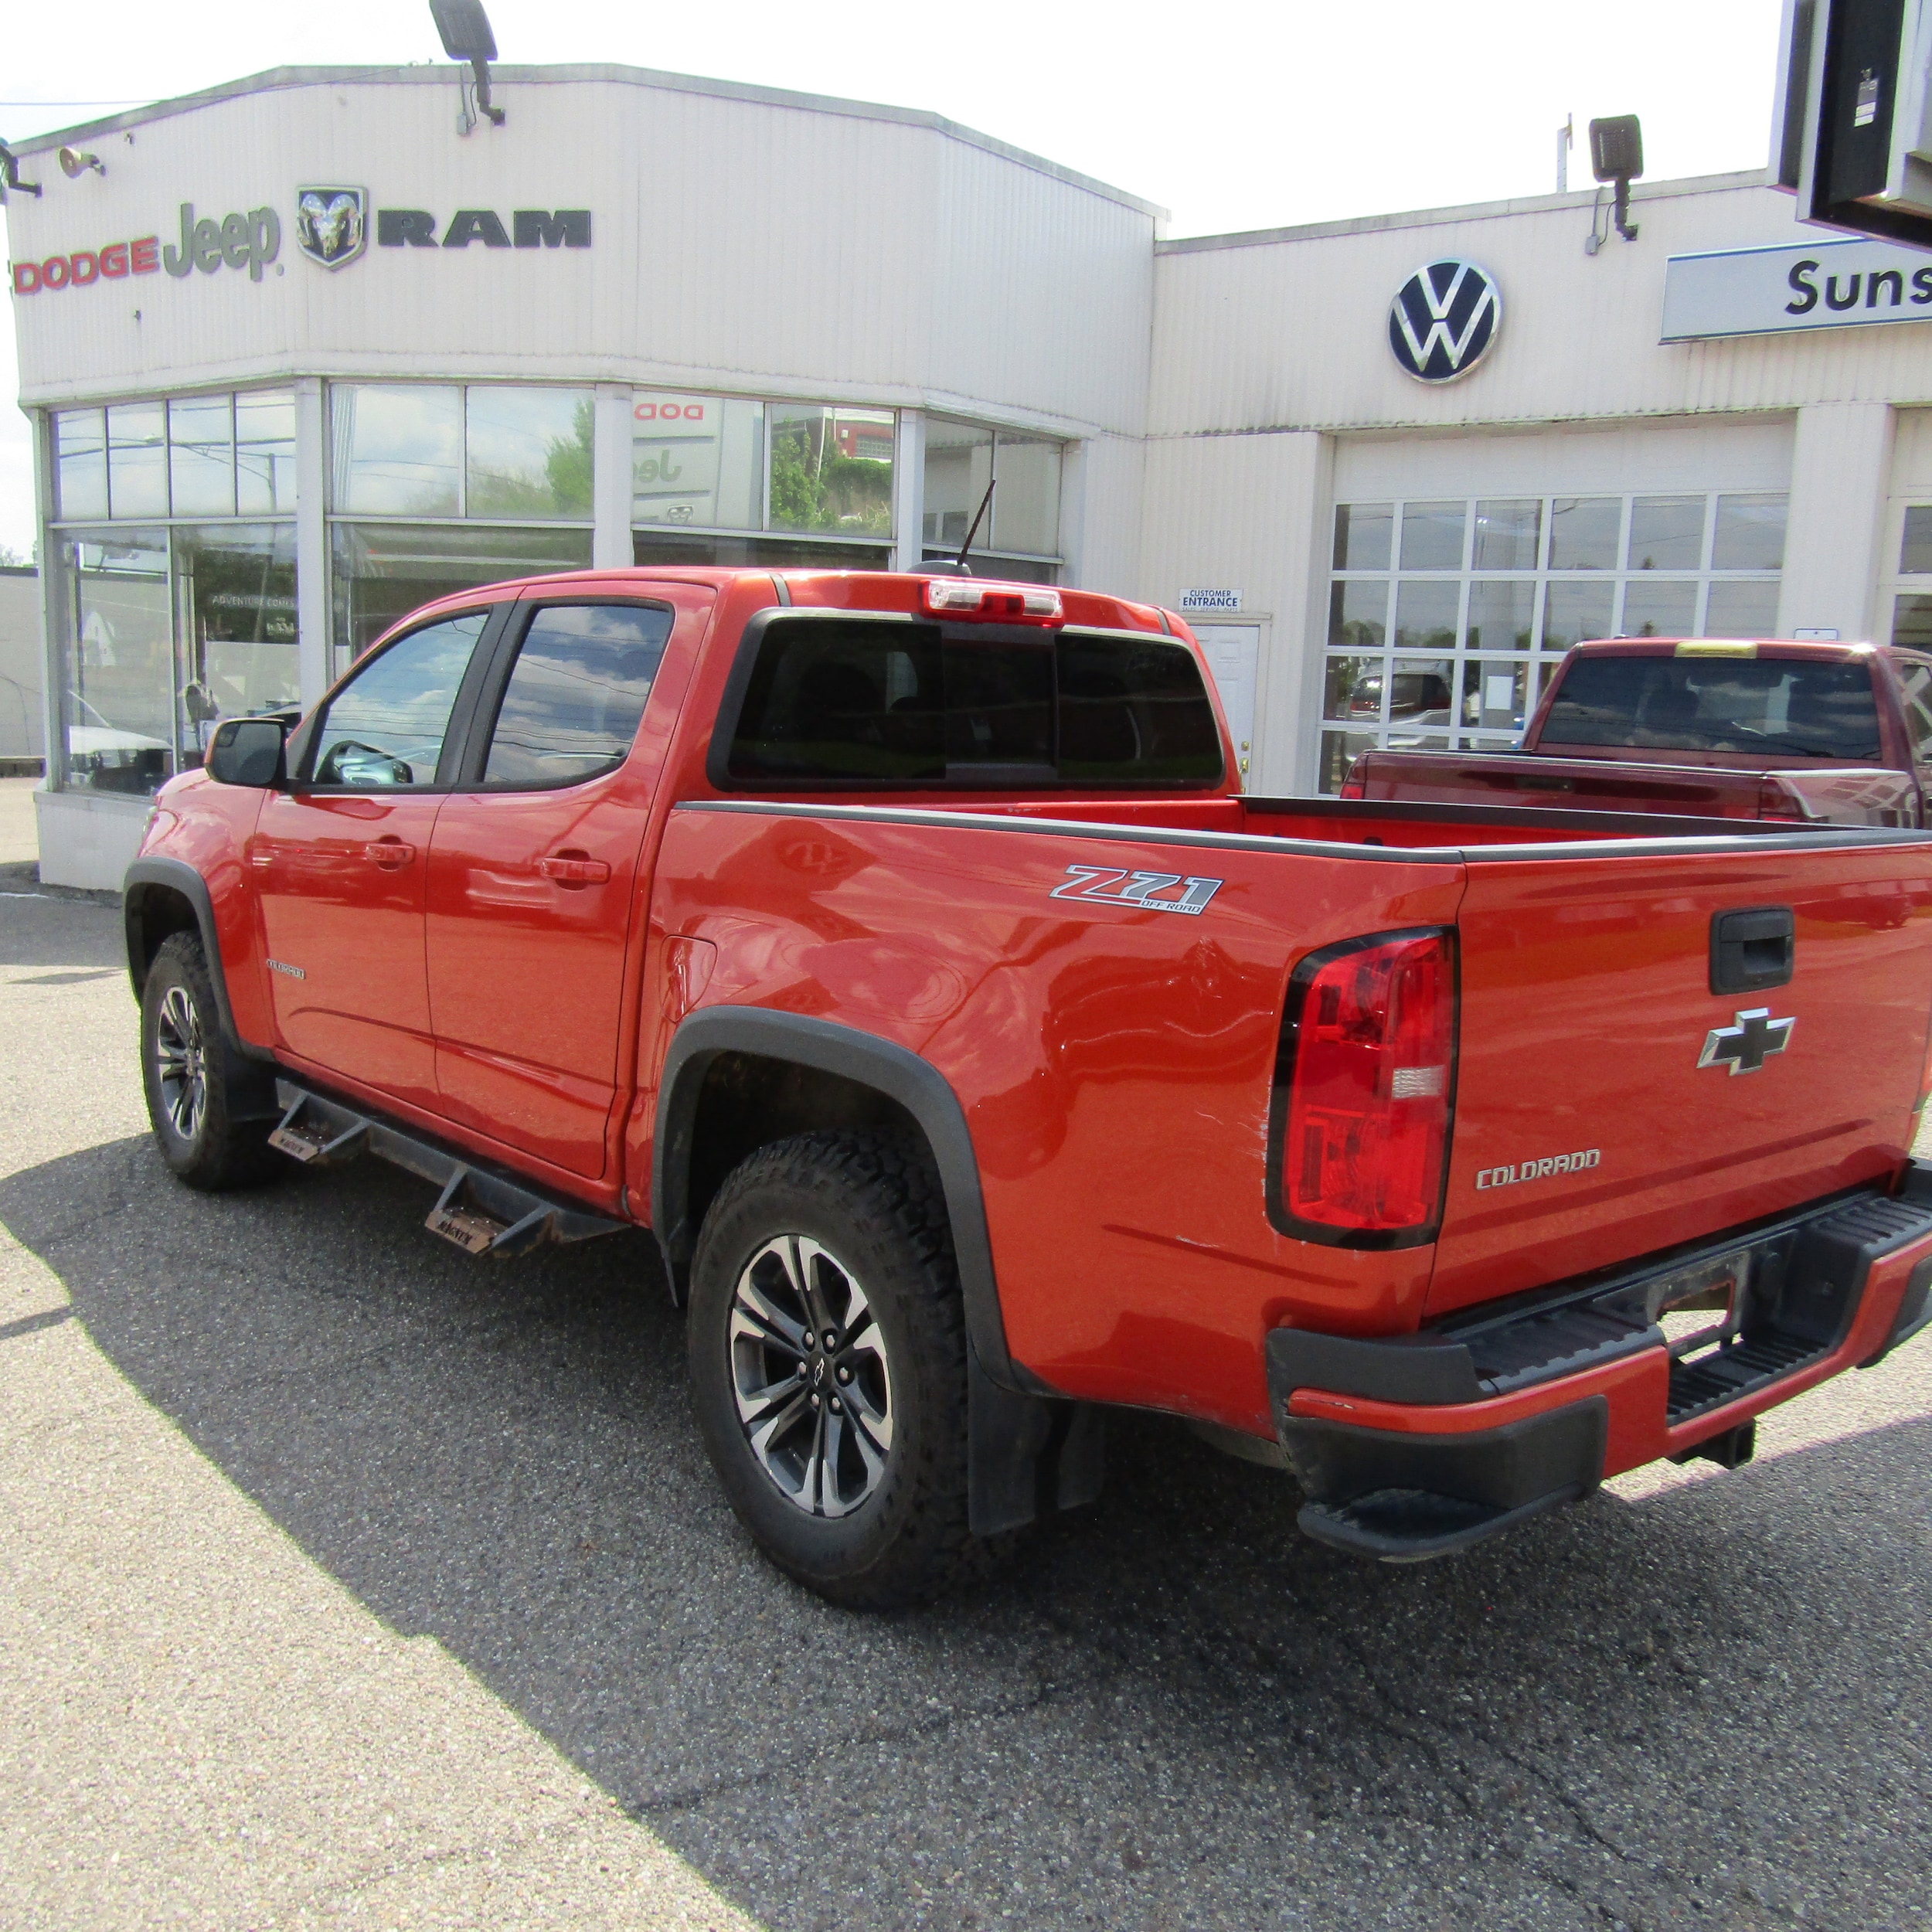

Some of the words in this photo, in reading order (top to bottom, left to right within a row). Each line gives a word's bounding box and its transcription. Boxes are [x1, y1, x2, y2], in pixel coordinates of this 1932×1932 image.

[163, 203, 281, 282] Jeep
[378, 209, 591, 248] RAM
[13, 235, 160, 296] DODGE
[1784, 260, 1932, 315] Suns
[1182, 597, 1238, 607] ENTRANCE
[1049, 863, 1226, 908] Z71
[1141, 900, 1165, 908] OFF
[1166, 903, 1201, 913] ROAD
[1476, 1148, 1600, 1190] COLORADO
